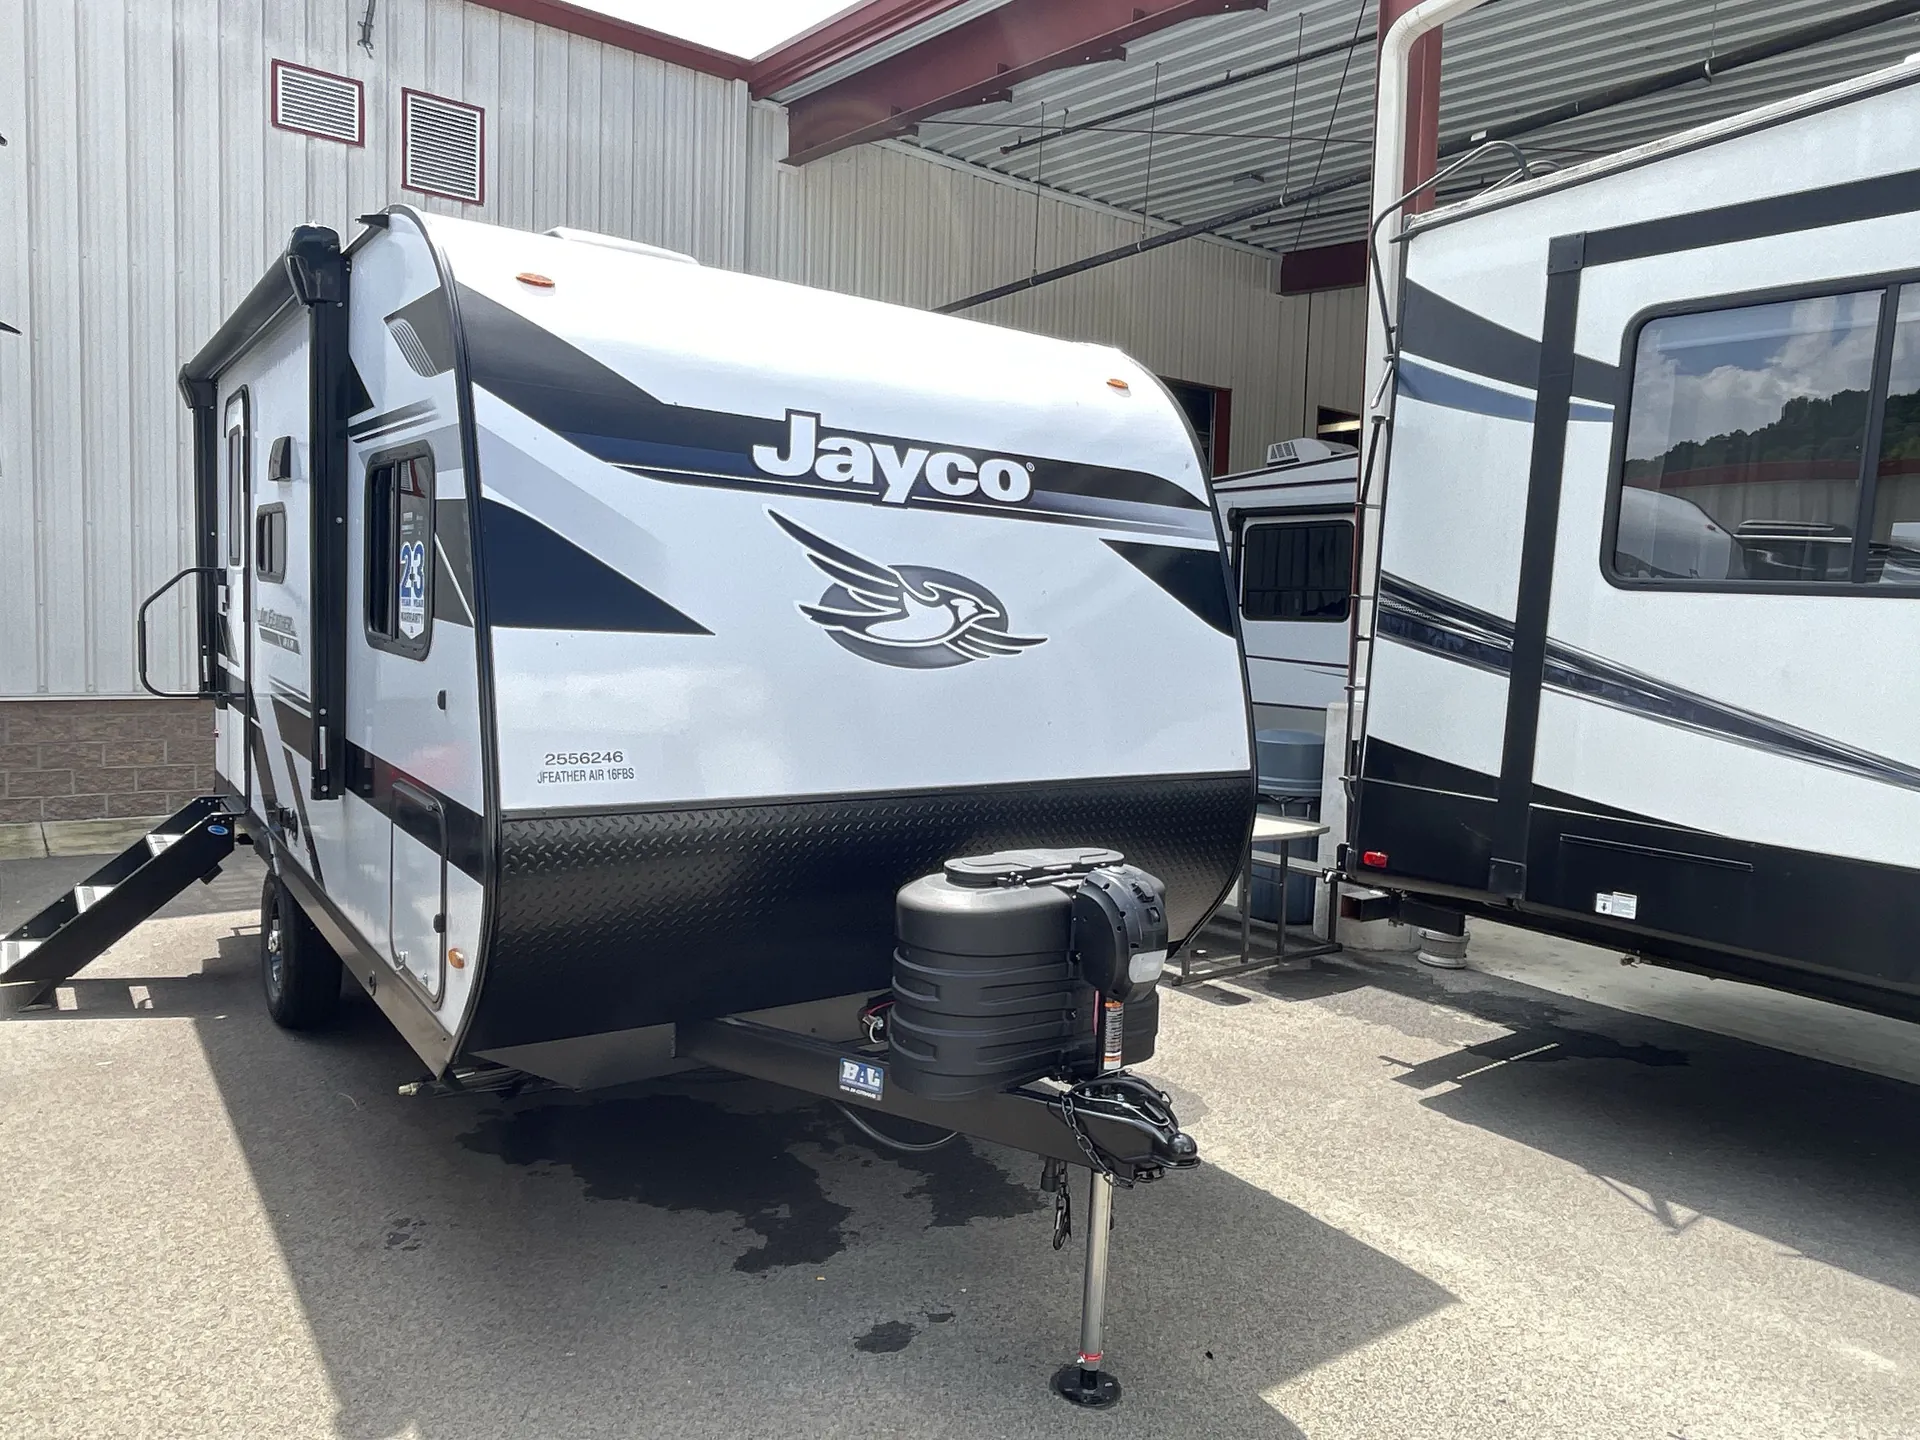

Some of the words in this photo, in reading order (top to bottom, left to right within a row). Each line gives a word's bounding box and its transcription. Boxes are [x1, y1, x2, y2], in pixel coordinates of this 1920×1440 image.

[752, 413, 1031, 504] Jayco
[544, 750, 624, 766] 2556246
[537, 769, 587, 784] JFEATHER
[588, 769, 605, 781] AIR
[606, 767, 635, 780] 16FBS
